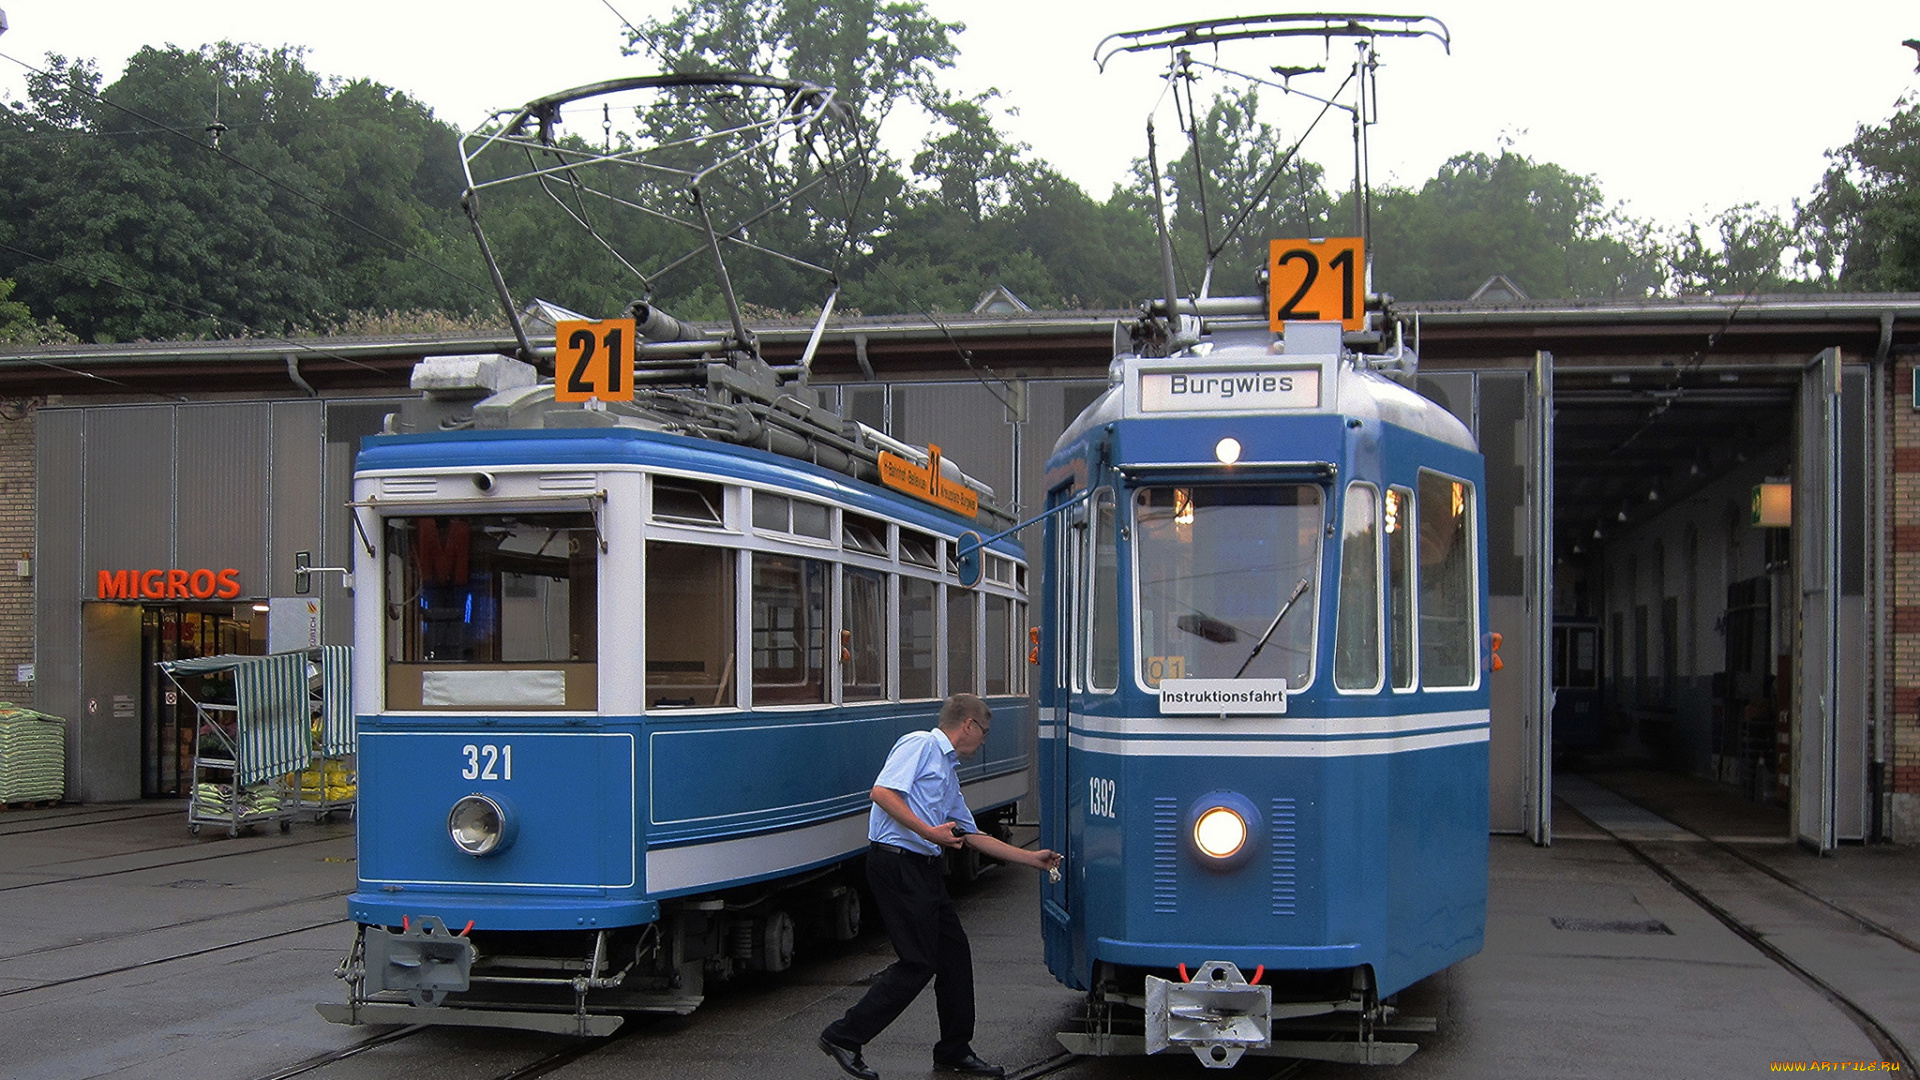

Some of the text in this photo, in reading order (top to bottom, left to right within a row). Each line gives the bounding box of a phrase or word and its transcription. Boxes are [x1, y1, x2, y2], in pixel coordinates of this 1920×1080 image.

[1278, 248, 1354, 321] 21
[568, 328, 622, 393] 21
[1170, 372, 1294, 398] Burgwies
[929, 450, 940, 498] 21
[97, 568, 241, 600] MIGROS
[1162, 690, 1284, 703] Instruktionsfahrt
[461, 744, 512, 780] 321
[1089, 776, 1116, 819] 1392
